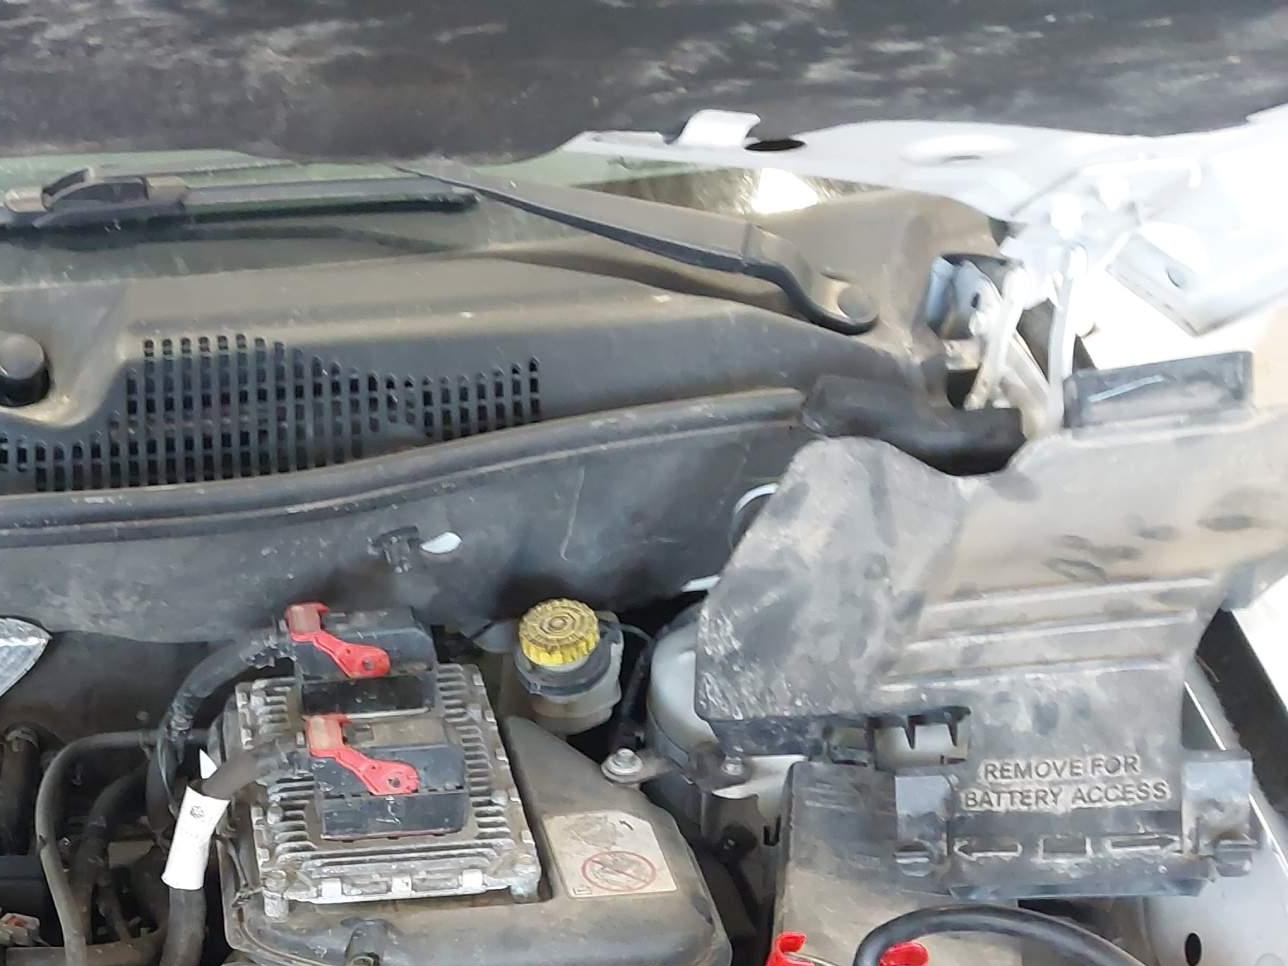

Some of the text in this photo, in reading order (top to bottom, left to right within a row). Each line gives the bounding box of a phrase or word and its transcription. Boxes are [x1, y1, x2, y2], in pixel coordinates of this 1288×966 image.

[984, 755, 1139, 780] REMOVE FOR
[965, 782, 1167, 808] BATTERY ACCESS
